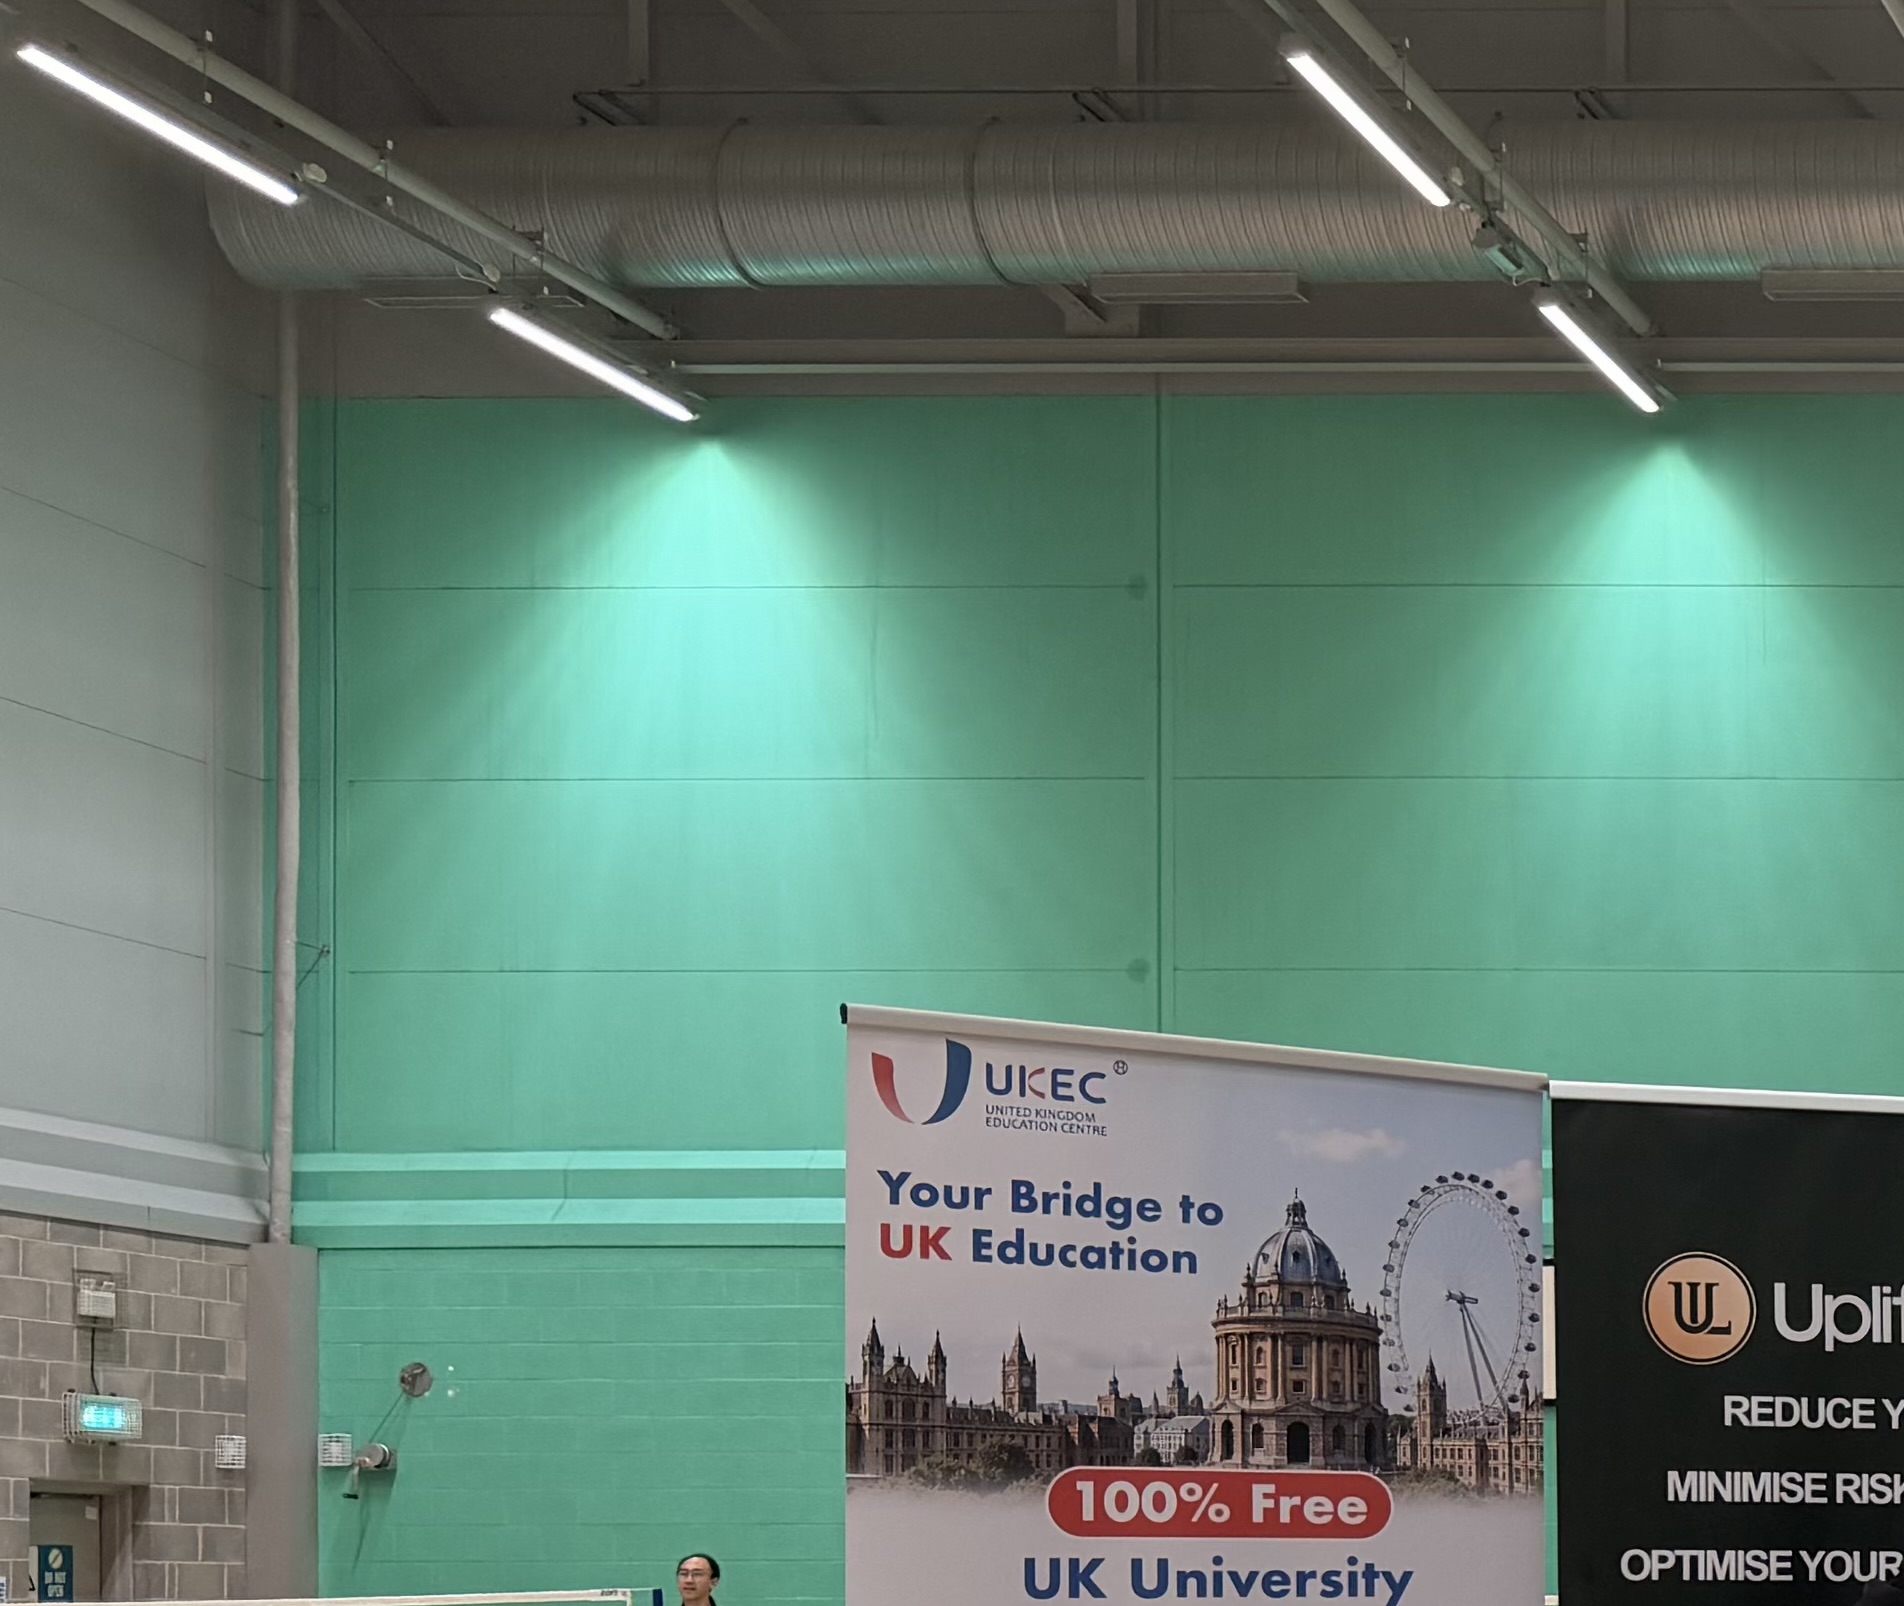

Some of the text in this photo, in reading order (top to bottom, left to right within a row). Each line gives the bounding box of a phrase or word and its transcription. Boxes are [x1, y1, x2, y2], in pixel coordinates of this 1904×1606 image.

[986, 1063, 1106, 1104] UKEC
[986, 1105, 1095, 1122] UNITED KINGDOM
[986, 1116, 1107, 1136] EDUCATION CENTRE
[877, 1170, 1223, 1230] Your Bridge to
[881, 1223, 1197, 1274] UK Education
[1724, 1396, 1876, 1429] REDUCE
[1077, 1481, 1367, 1524] 100% Free
[1668, 1471, 1827, 1503] MINIMISE
[1025, 1558, 1106, 1599] UK
[1621, 1549, 1903, 1581] OPTIMISE YOUR
